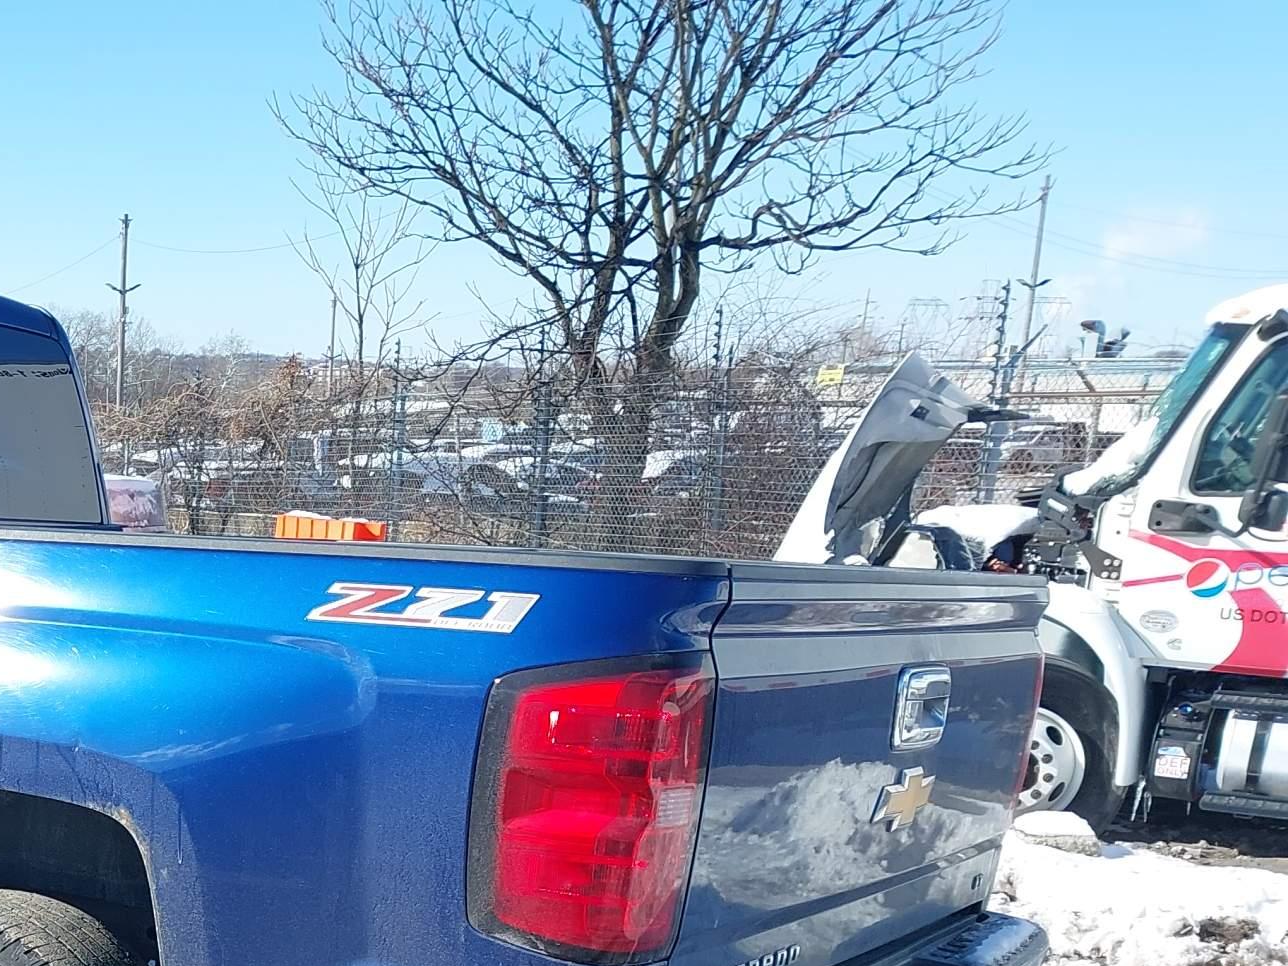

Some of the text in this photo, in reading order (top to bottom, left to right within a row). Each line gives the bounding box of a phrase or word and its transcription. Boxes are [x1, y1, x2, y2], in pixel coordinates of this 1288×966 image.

[306, 581, 540, 633] Z71
[1220, 608, 1288, 625] US DOT
[1159, 757, 1189, 768] DEF
[1158, 768, 1188, 776] ONLY
